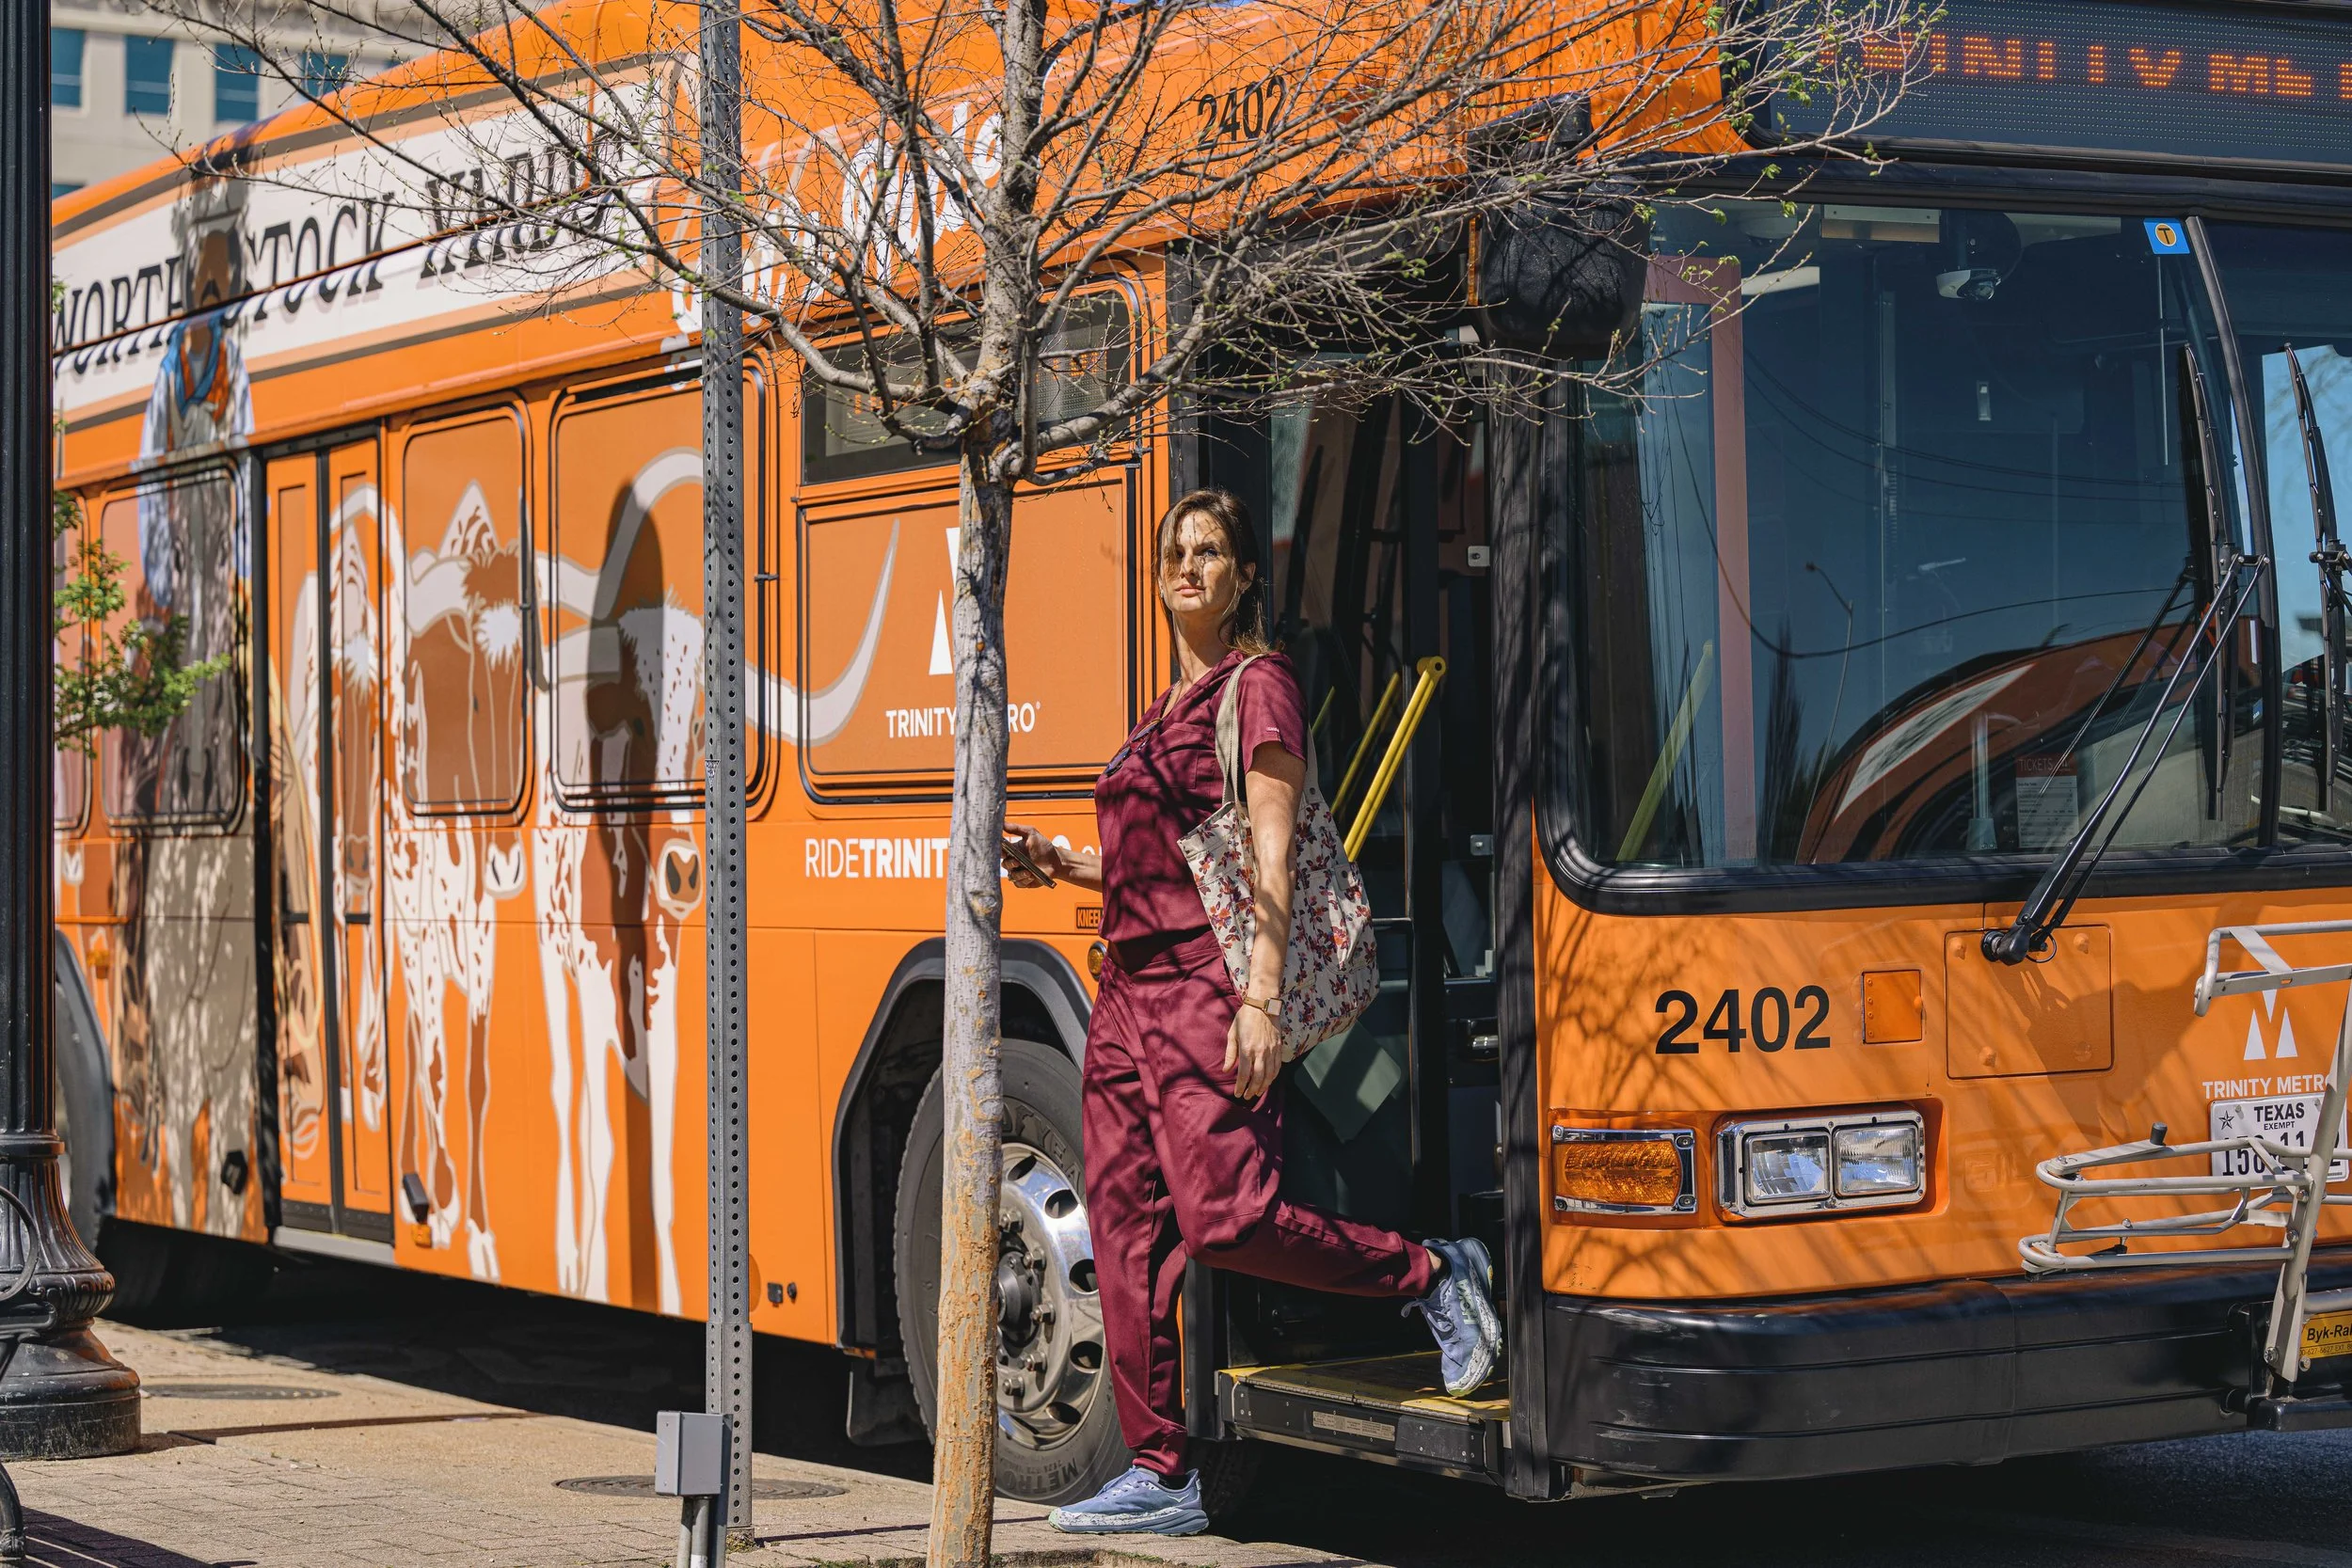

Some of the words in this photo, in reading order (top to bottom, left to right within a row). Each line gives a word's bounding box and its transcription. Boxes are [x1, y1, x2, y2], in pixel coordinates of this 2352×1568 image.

[1197, 74, 1288, 151] 2402
[885, 706, 957, 738] TRINITY
[1655, 985, 1831, 1054] 2402
[2202, 1077, 2271, 1100] TRINITY
[2254, 1101, 2305, 1123] TEXAS
[2264, 1120, 2296, 1131] EXEMPT
